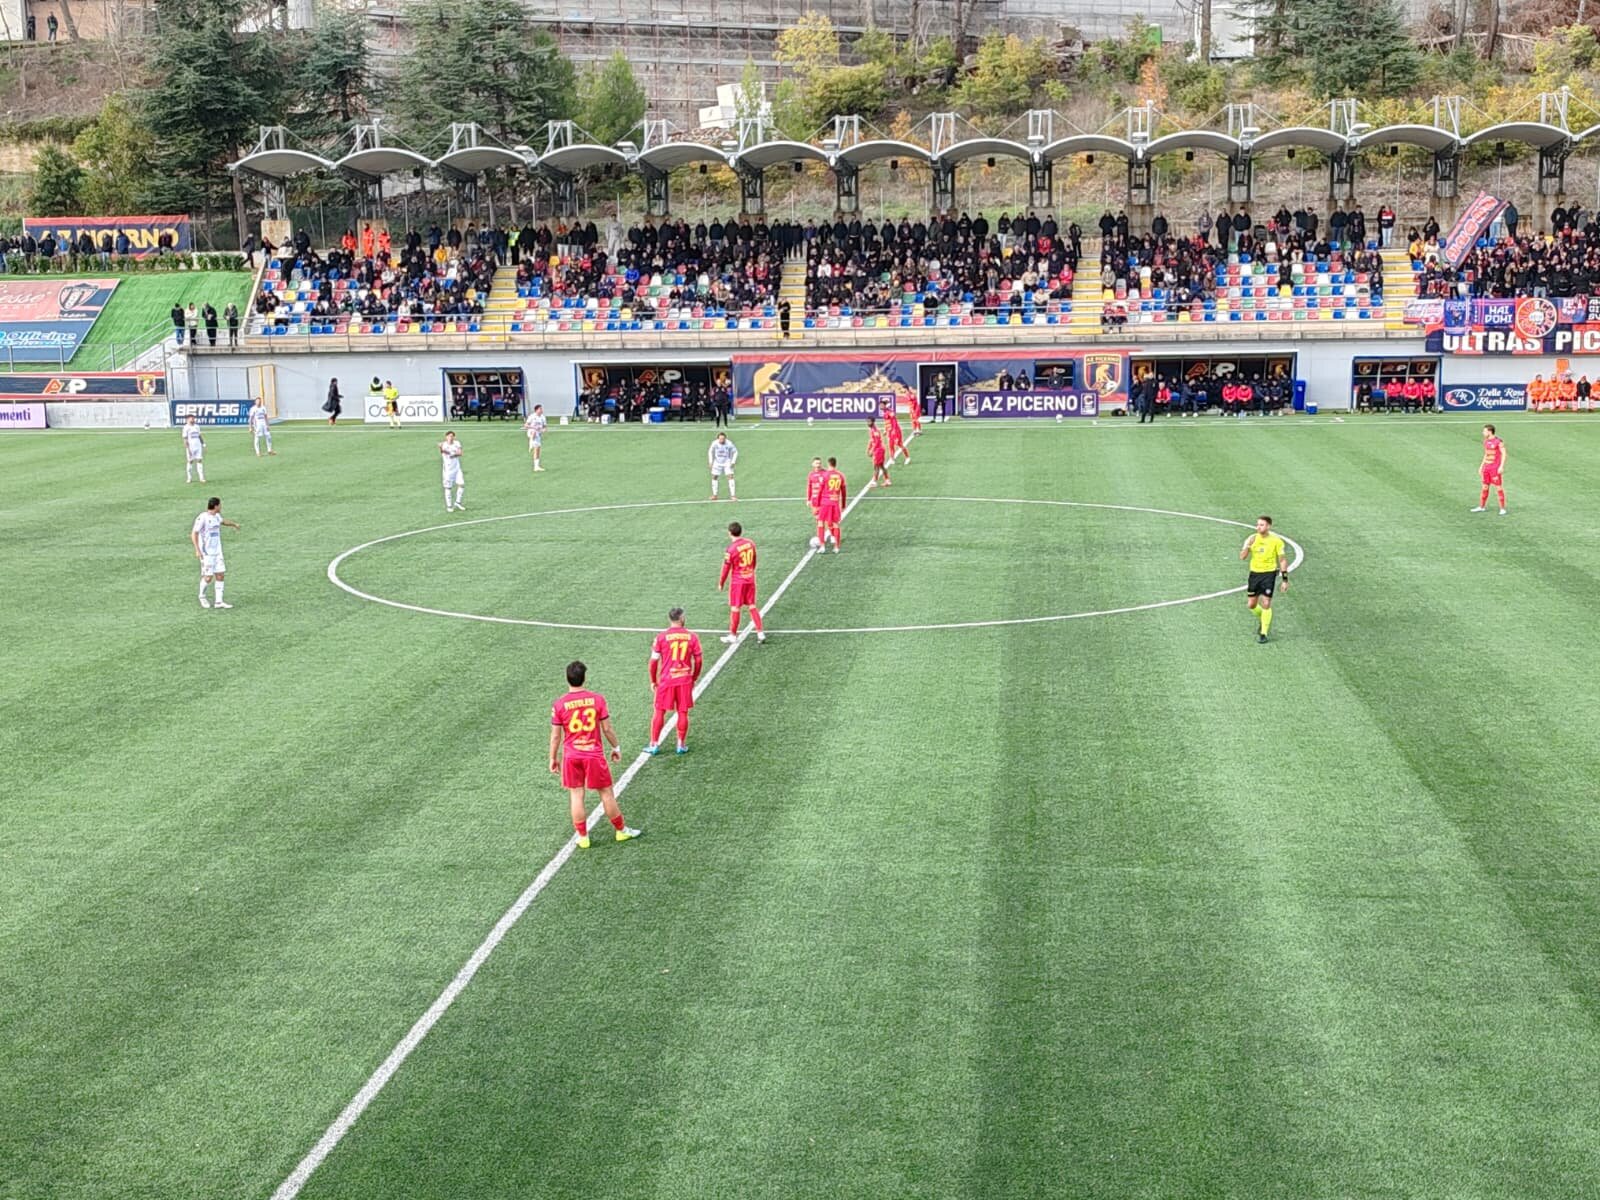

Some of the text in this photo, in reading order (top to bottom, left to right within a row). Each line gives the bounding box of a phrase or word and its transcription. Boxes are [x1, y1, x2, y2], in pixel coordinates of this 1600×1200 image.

[1443, 331, 1541, 351] ULTRAS
[781, 397, 876, 413] AZ PICERNO
[980, 395, 1078, 411] AZ PICERNO
[828, 477, 841, 491] 90
[739, 550, 754, 567] 30
[670, 641, 689, 661] 11
[569, 708, 597, 733] 63
